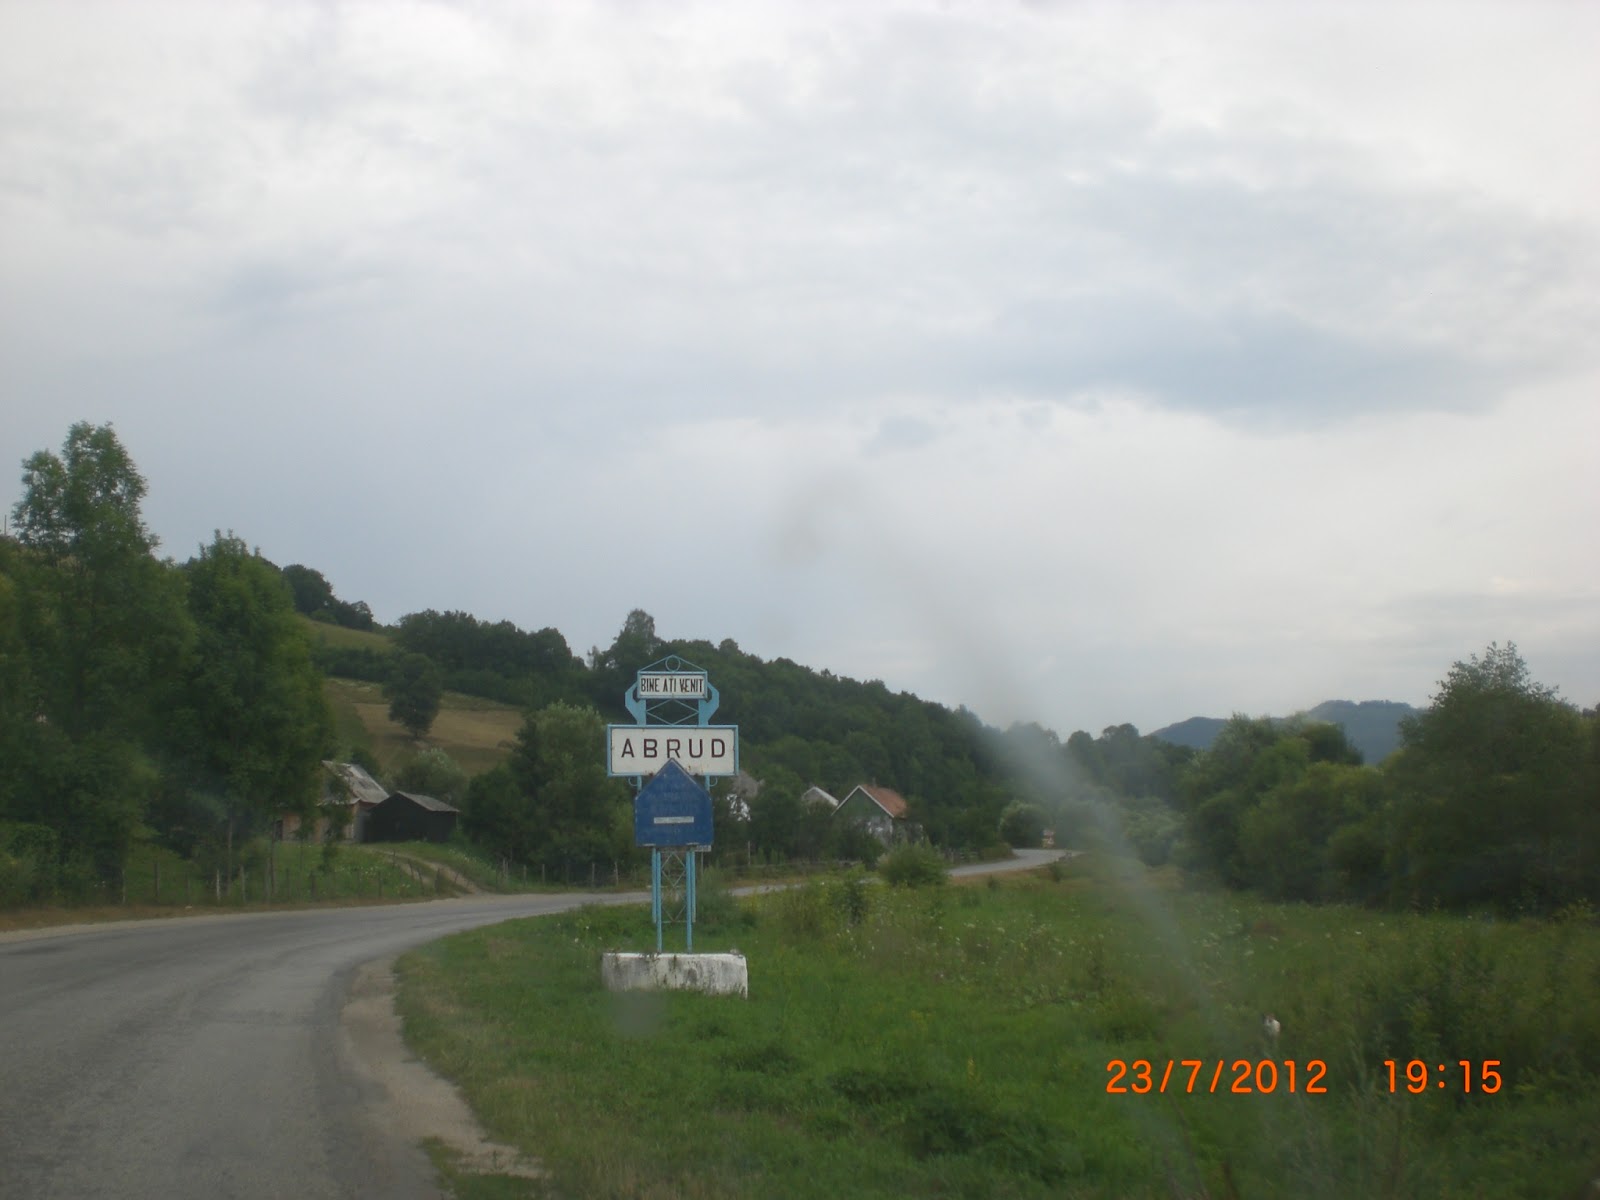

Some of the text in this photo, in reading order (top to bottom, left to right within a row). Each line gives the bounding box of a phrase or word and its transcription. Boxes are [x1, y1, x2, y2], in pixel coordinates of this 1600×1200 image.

[640, 678, 660, 693] BINE
[680, 678, 704, 693] VENIT
[621, 738, 726, 759] ABRUD
